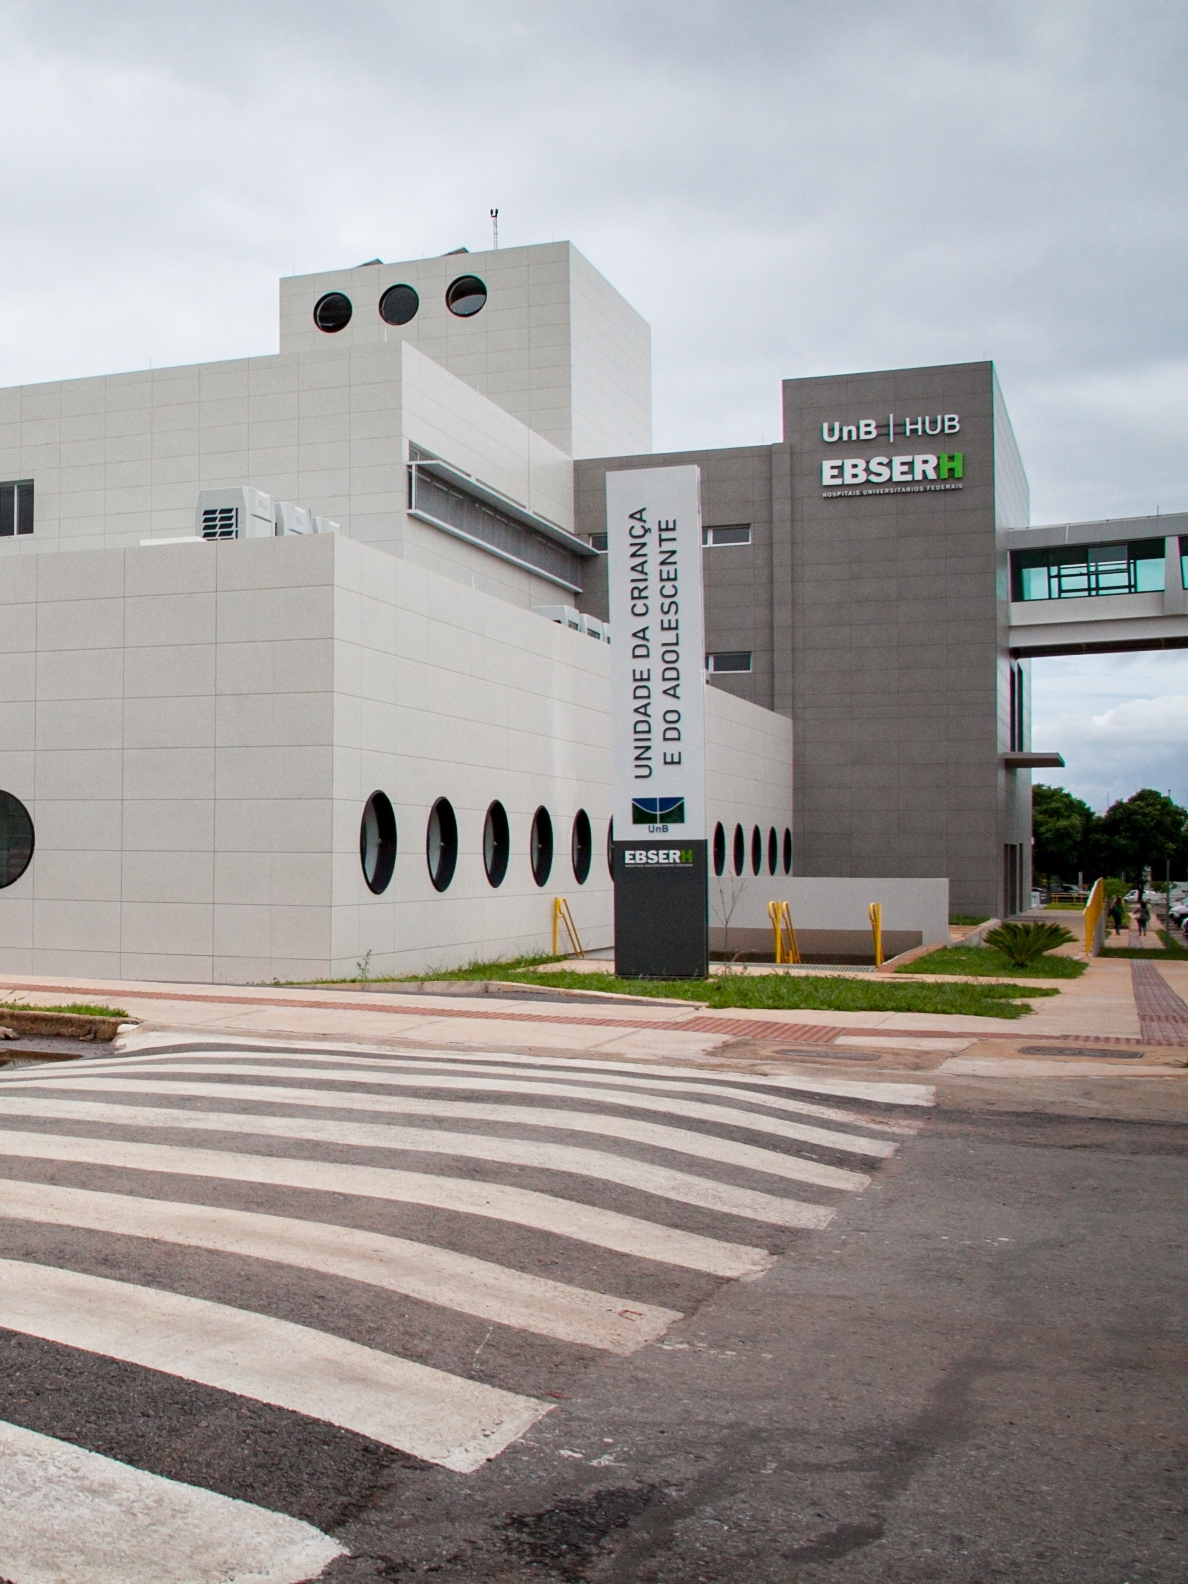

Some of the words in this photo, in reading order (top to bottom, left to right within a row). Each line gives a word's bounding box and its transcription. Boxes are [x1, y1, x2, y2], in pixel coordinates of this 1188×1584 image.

[822, 419, 878, 443] UnB
[905, 414, 960, 437] HUB
[821, 452, 963, 486] EBSERH
[822, 490, 861, 498] HOSPITAIS
[926, 483, 963, 491] FEDERAIS
[628, 506, 652, 617] CRIANÇA
[658, 519, 680, 700] ADOLESCENTE
[631, 626, 650, 659] DA
[632, 668, 653, 779] UNIDADE
[662, 709, 681, 742] DO
[663, 751, 682, 766] E
[648, 825, 669, 833] UnB
[624, 849, 693, 864] EBSERH
